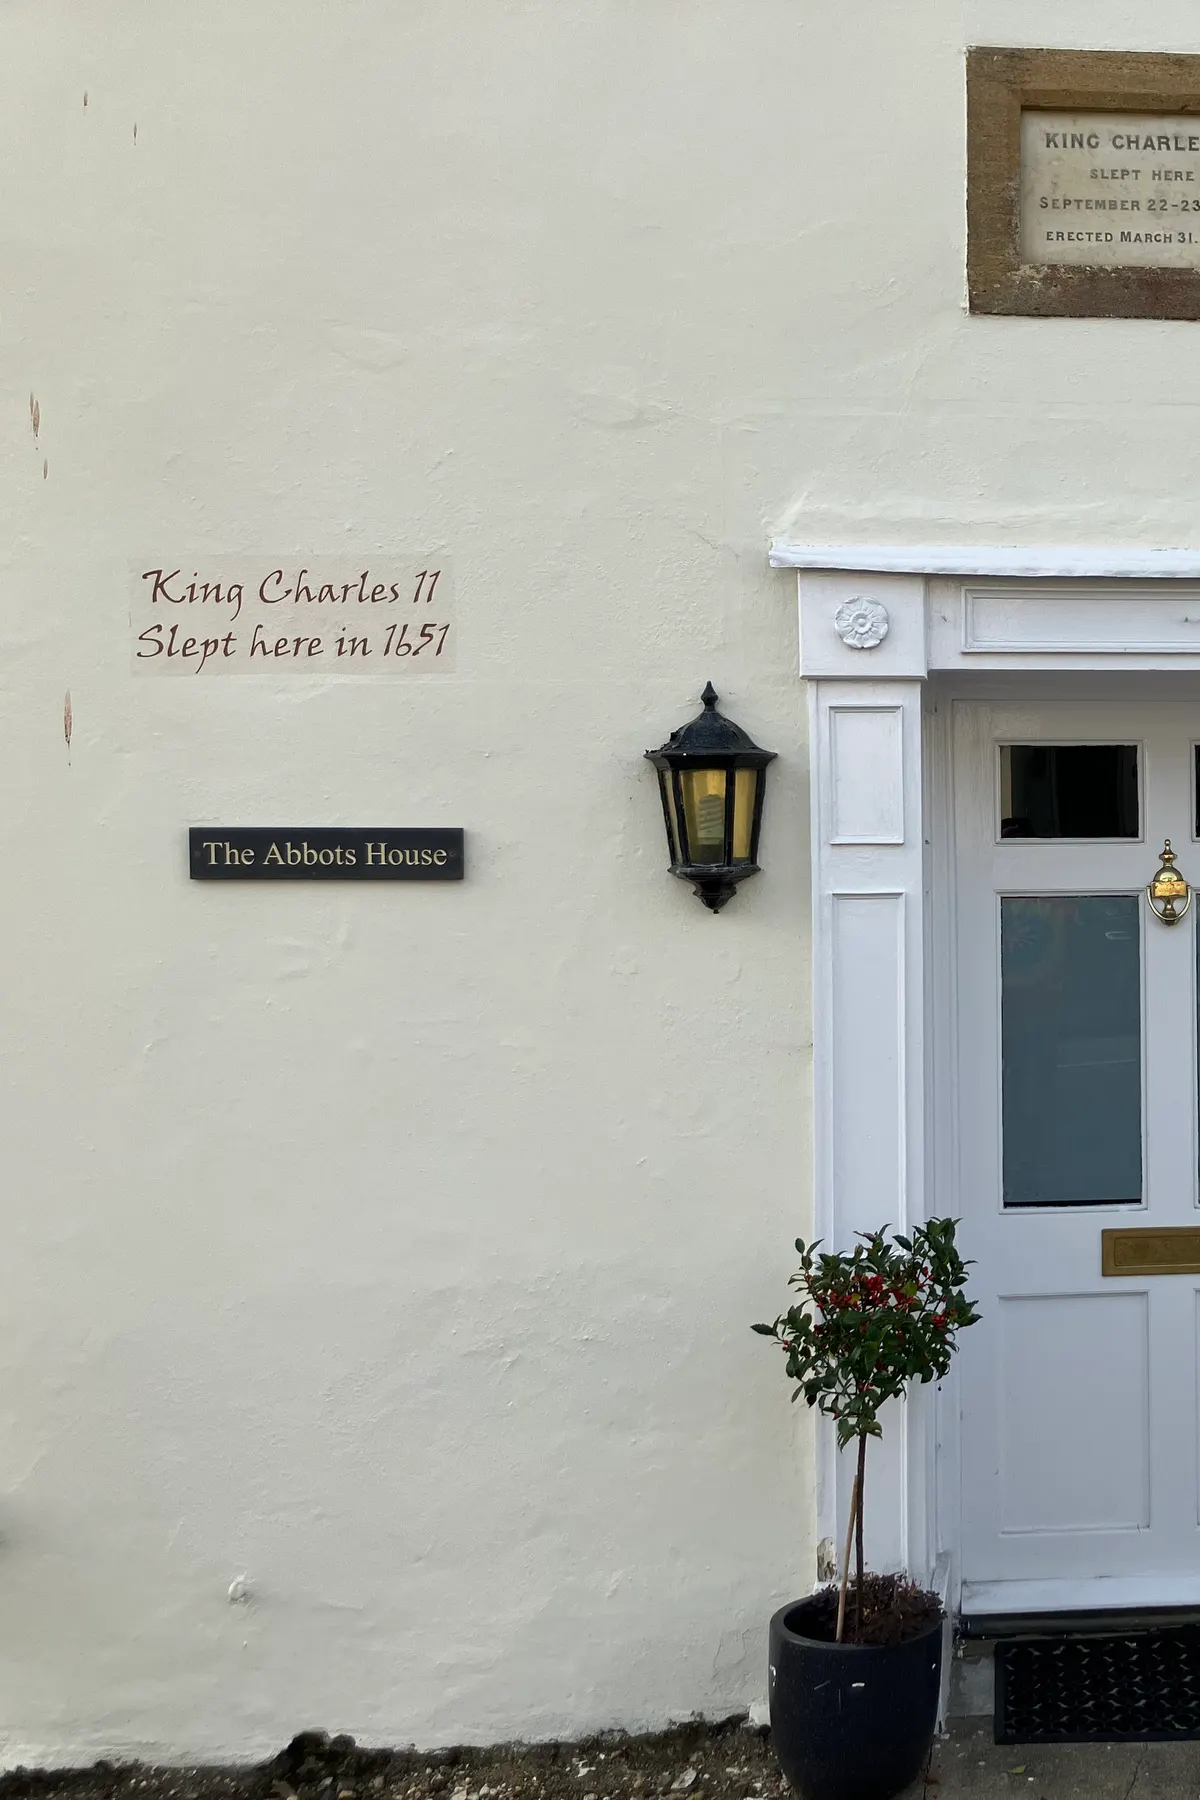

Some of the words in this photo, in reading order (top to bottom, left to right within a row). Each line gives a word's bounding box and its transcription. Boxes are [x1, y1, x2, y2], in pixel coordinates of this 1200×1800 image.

[1046, 133, 1099, 150] KING
[1090, 169, 1141, 181] SLEPT
[1152, 170, 1195, 182] HERE
[1039, 197, 1140, 212] SEPTEMBER
[1046, 231, 1113, 243] ERECTED
[1120, 231, 1172, 244] MARCH
[141, 569, 245, 622] King
[258, 569, 400, 604] Charles
[136, 623, 238, 675] Slept
[249, 624, 325, 658] here
[334, 627, 373, 657] in
[383, 623, 451, 658] 1651
[202, 841, 255, 866] The
[262, 841, 357, 866] Abbots
[364, 842, 447, 866] House
